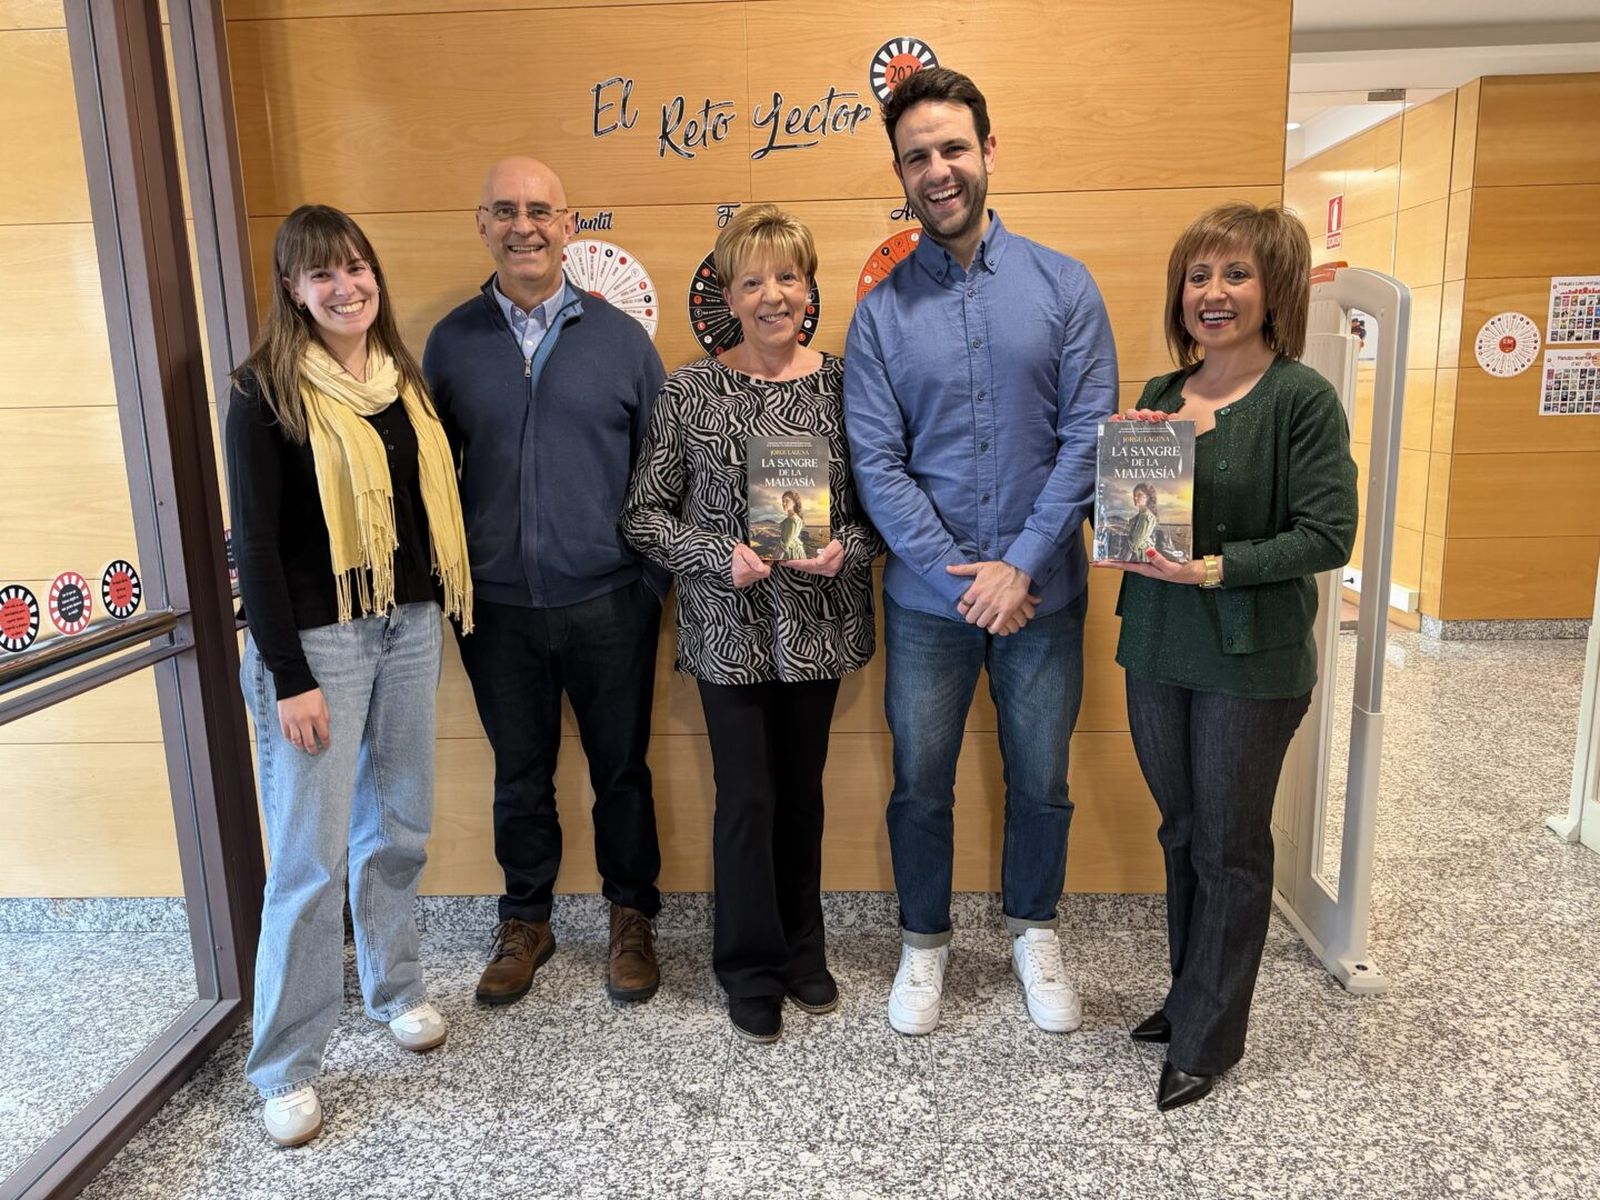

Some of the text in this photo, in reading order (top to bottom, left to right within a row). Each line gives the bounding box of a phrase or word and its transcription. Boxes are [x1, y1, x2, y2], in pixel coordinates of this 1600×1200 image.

[592, 77, 872, 160] El Reto Lector
[575, 211, 613, 234] fantil
[1112, 446, 1180, 457] LA SANGRE
[761, 458, 818, 468] LA SANGRE
[1114, 465, 1176, 479] MALVASÍA
[765, 475, 816, 487] MALVASÍA
